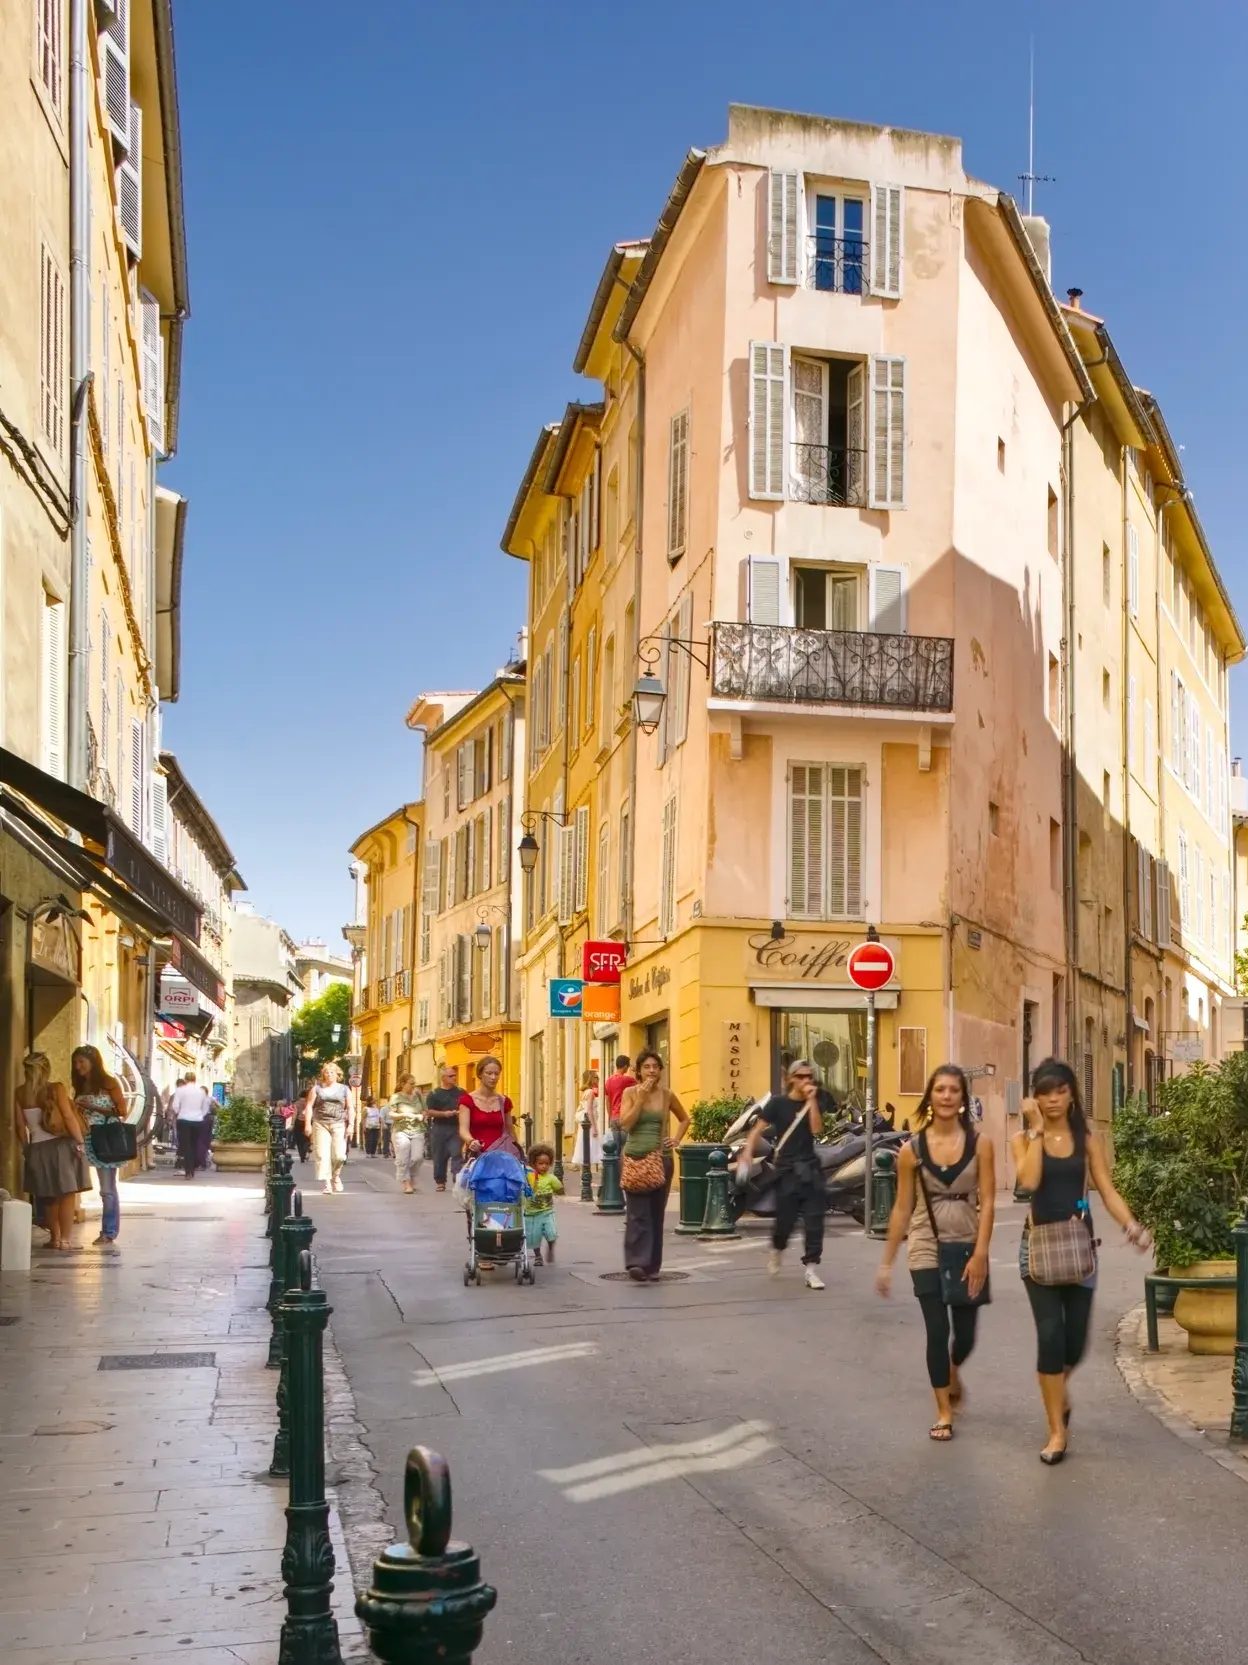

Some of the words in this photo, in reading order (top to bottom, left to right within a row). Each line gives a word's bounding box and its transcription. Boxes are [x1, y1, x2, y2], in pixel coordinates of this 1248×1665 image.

[590, 953, 622, 971] SFR
[748, 933, 849, 978] Coiffu
[164, 995, 195, 1003] ORPI
[584, 1011, 616, 1020] orange
[728, 1022, 741, 1100] MASCULI
